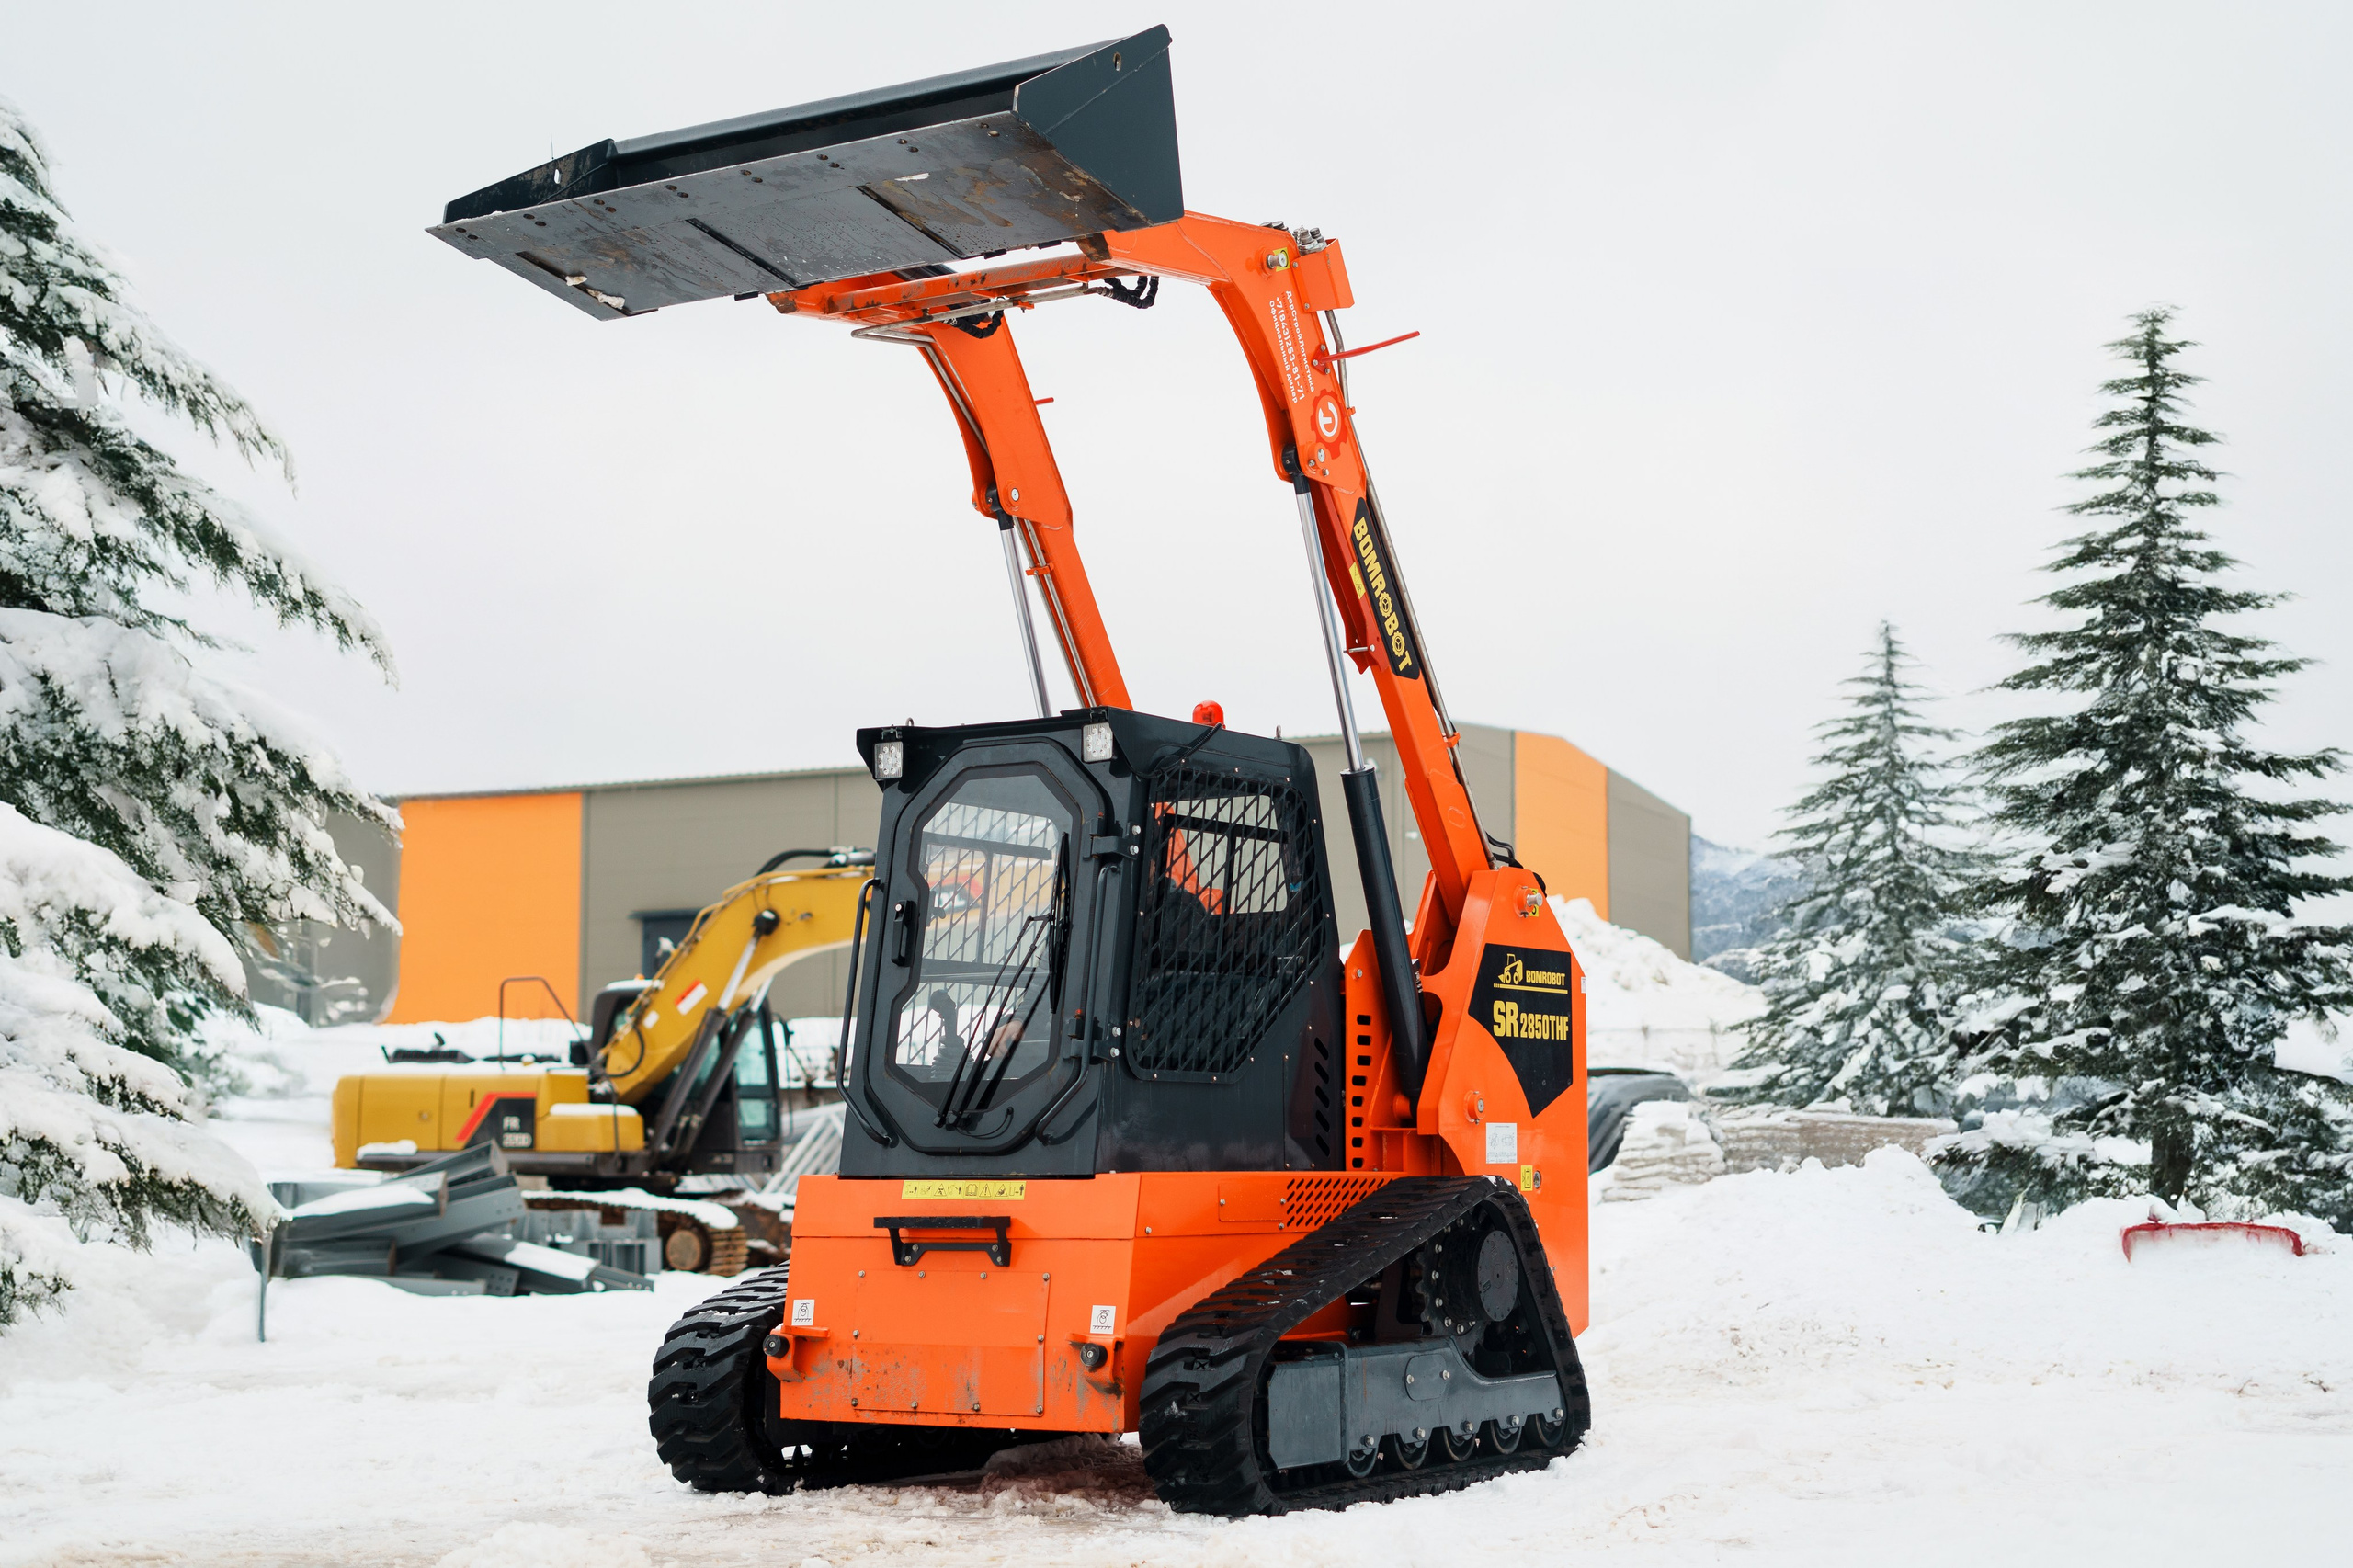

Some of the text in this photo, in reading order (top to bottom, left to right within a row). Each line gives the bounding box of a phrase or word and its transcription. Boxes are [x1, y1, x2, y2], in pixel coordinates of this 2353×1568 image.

[1269, 301, 1298, 403] Официальный дилер
[1276, 297, 1305, 400] +7(843)253-81-71
[1286, 290, 1314, 392] ДорСтройЛогистика
[1353, 516, 1412, 672] BOMROBOT
[1493, 1000, 1519, 1038] SR
[1526, 970, 1565, 986] BOMROBOT
